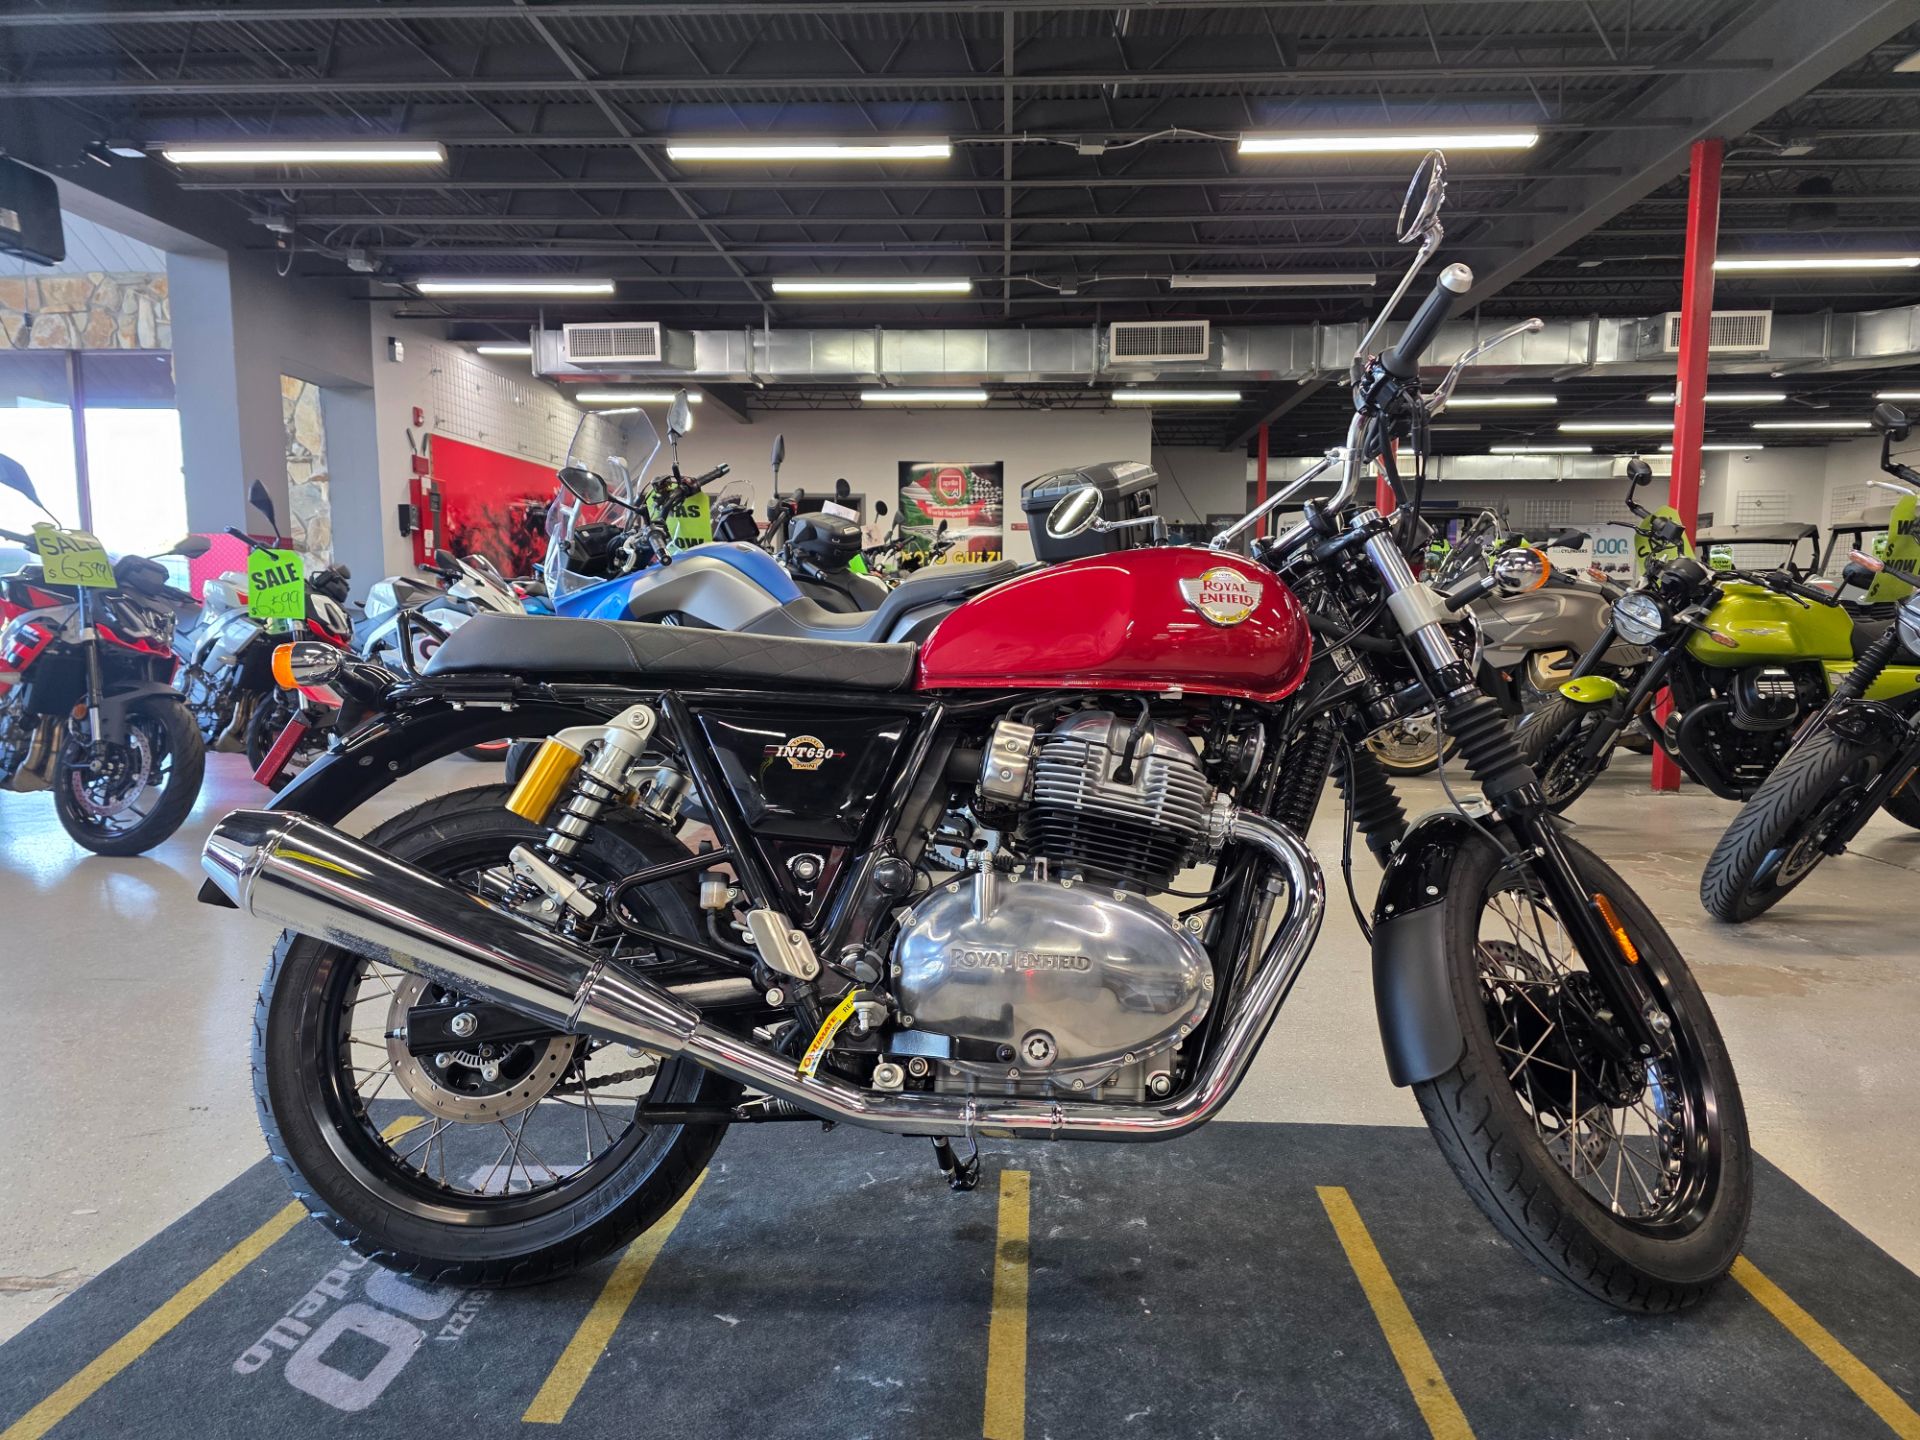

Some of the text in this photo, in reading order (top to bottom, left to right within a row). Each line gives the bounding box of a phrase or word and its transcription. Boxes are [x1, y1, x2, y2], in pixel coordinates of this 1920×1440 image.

[673, 503, 701, 518] AS
[40, 537, 103, 556] SALE
[673, 537, 704, 549] OW
[251, 562, 300, 591] SALE
[1203, 580, 1248, 593] ROYAL
[1199, 593, 1253, 607] ENFIELD
[775, 746, 834, 760] INT650
[950, 948, 1093, 973] ROYAL ENFIELD
